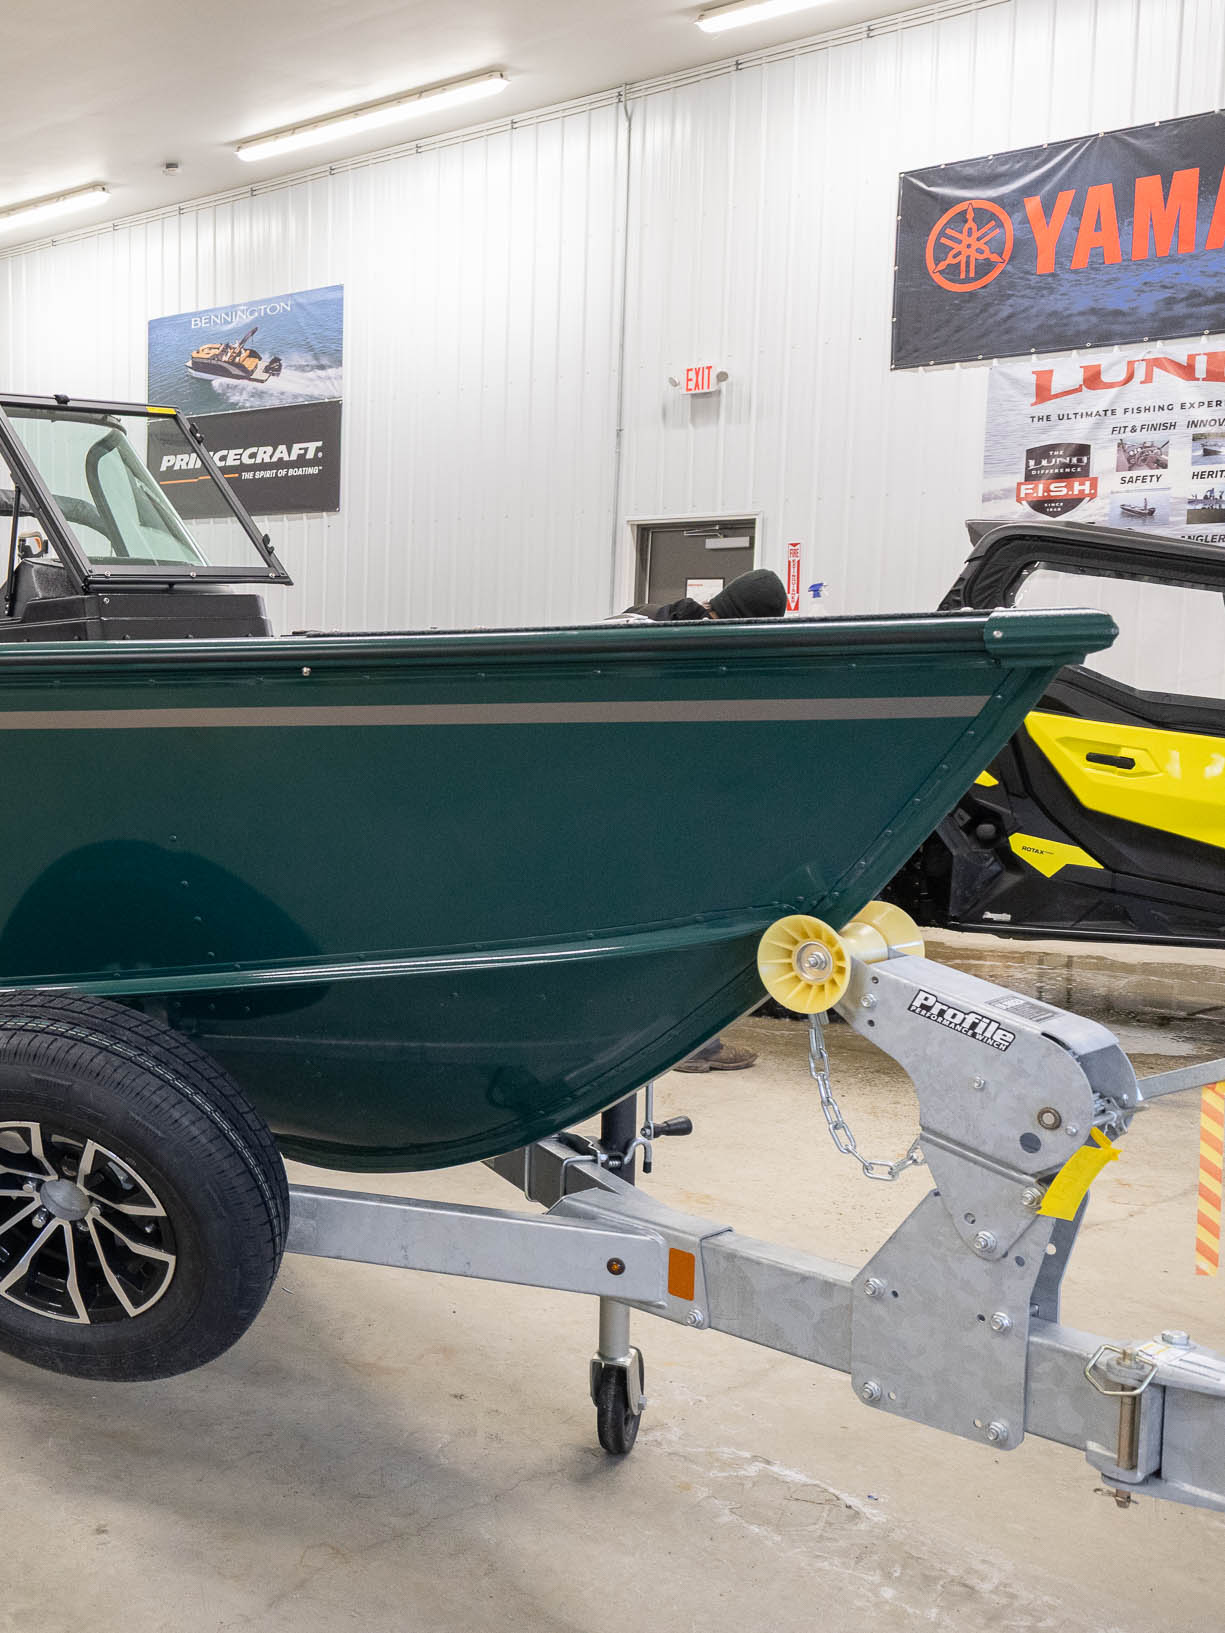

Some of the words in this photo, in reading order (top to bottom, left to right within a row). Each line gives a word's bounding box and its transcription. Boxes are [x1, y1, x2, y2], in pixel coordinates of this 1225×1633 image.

[191, 301, 291, 329] BENNINGTON
[685, 365, 713, 392] EXIT
[1030, 415, 1052, 423] THE
[1057, 408, 1117, 421] ULTIMATE
[1123, 403, 1174, 415] FISHING
[1111, 426, 1128, 435] FIT
[1130, 425, 1137, 433] &
[1139, 421, 1177, 432] FINISH
[1186, 417, 1225, 429] INNOV
[1027, 456, 1088, 470] LUND
[241, 471, 254, 480] THE
[255, 469, 277, 479] SPIRIT
[277, 468, 287, 477] OF
[288, 466, 319, 476] BOATING
[1031, 467, 1082, 475] DIFFERENCE
[1191, 469, 1225, 480] HERIT
[1120, 474, 1163, 485] SAFETY
[1020, 480, 1095, 498] F.I.S.H.
[1021, 845, 1044, 855] ROTAX
[912, 990, 1015, 1044] Profile
[910, 1005, 974, 1037] PERFORMANCE
[975, 1033, 1008, 1051] WINCH
